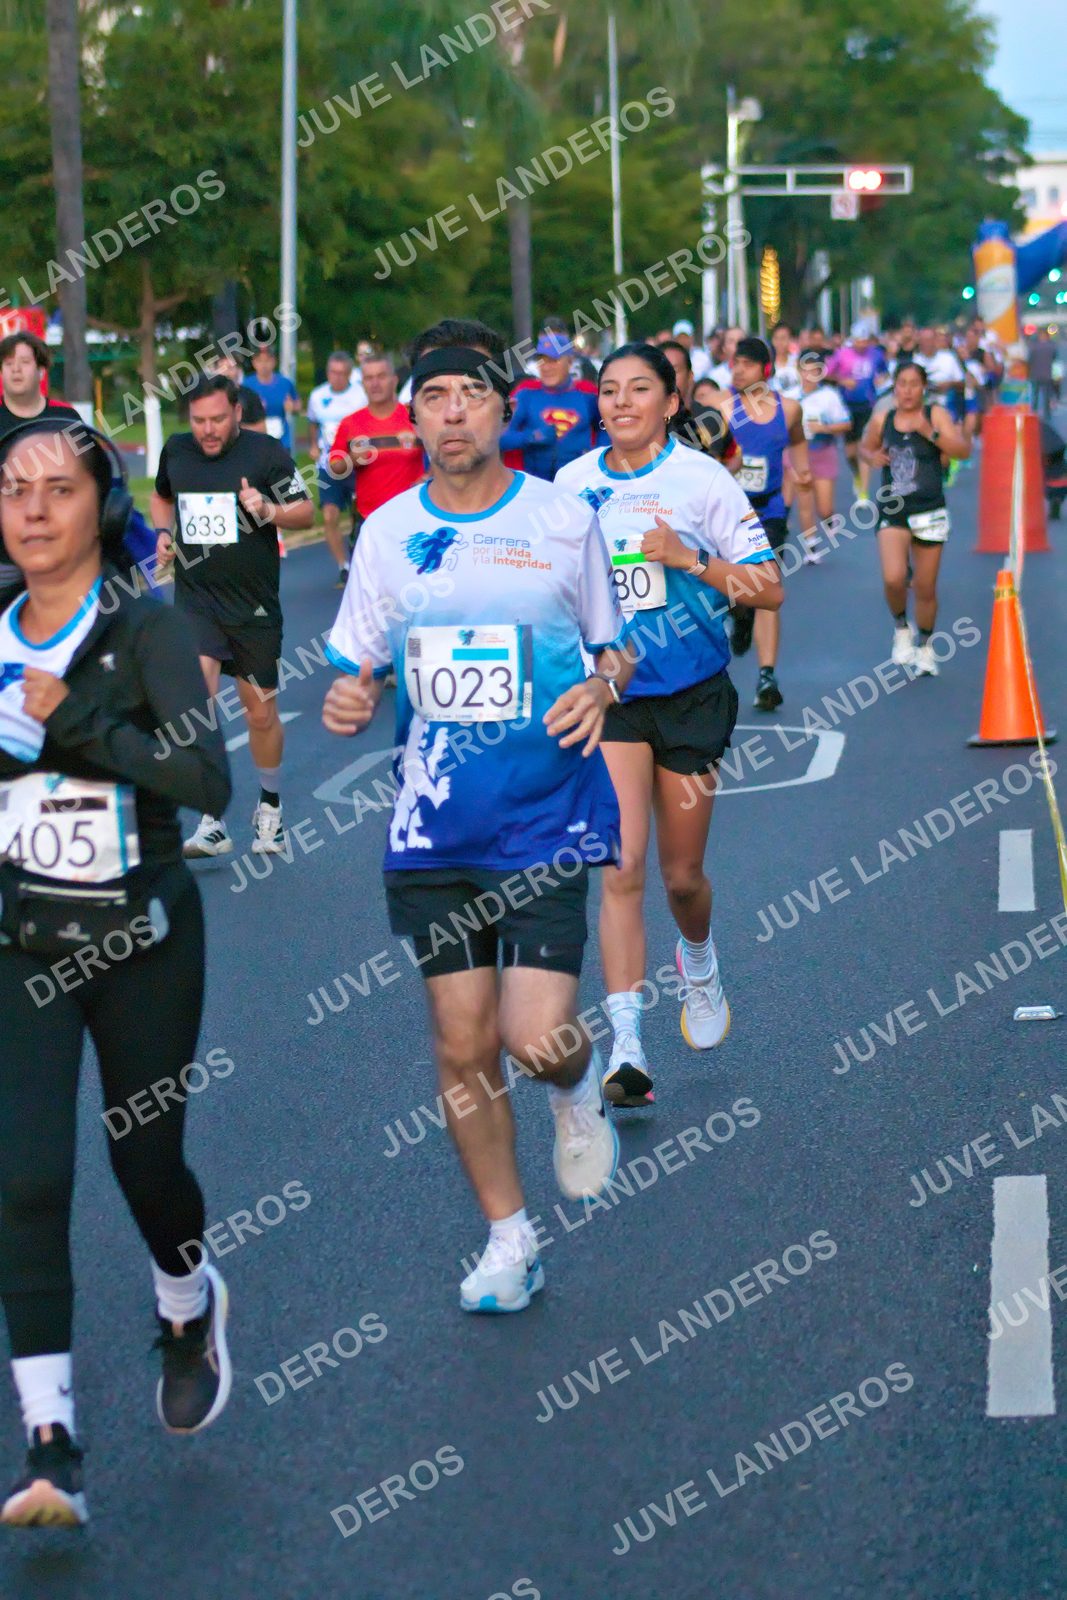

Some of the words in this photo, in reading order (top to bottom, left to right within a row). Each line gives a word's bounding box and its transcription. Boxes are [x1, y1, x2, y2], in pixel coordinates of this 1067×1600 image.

[186, 515, 226, 537] 633
[473, 533, 530, 548] Carrera
[473, 546, 490, 556] por
[493, 546, 503, 556] la
[505, 547, 531, 558] Vida
[493, 556, 552, 570] Integridad
[411, 666, 513, 709] 1023
